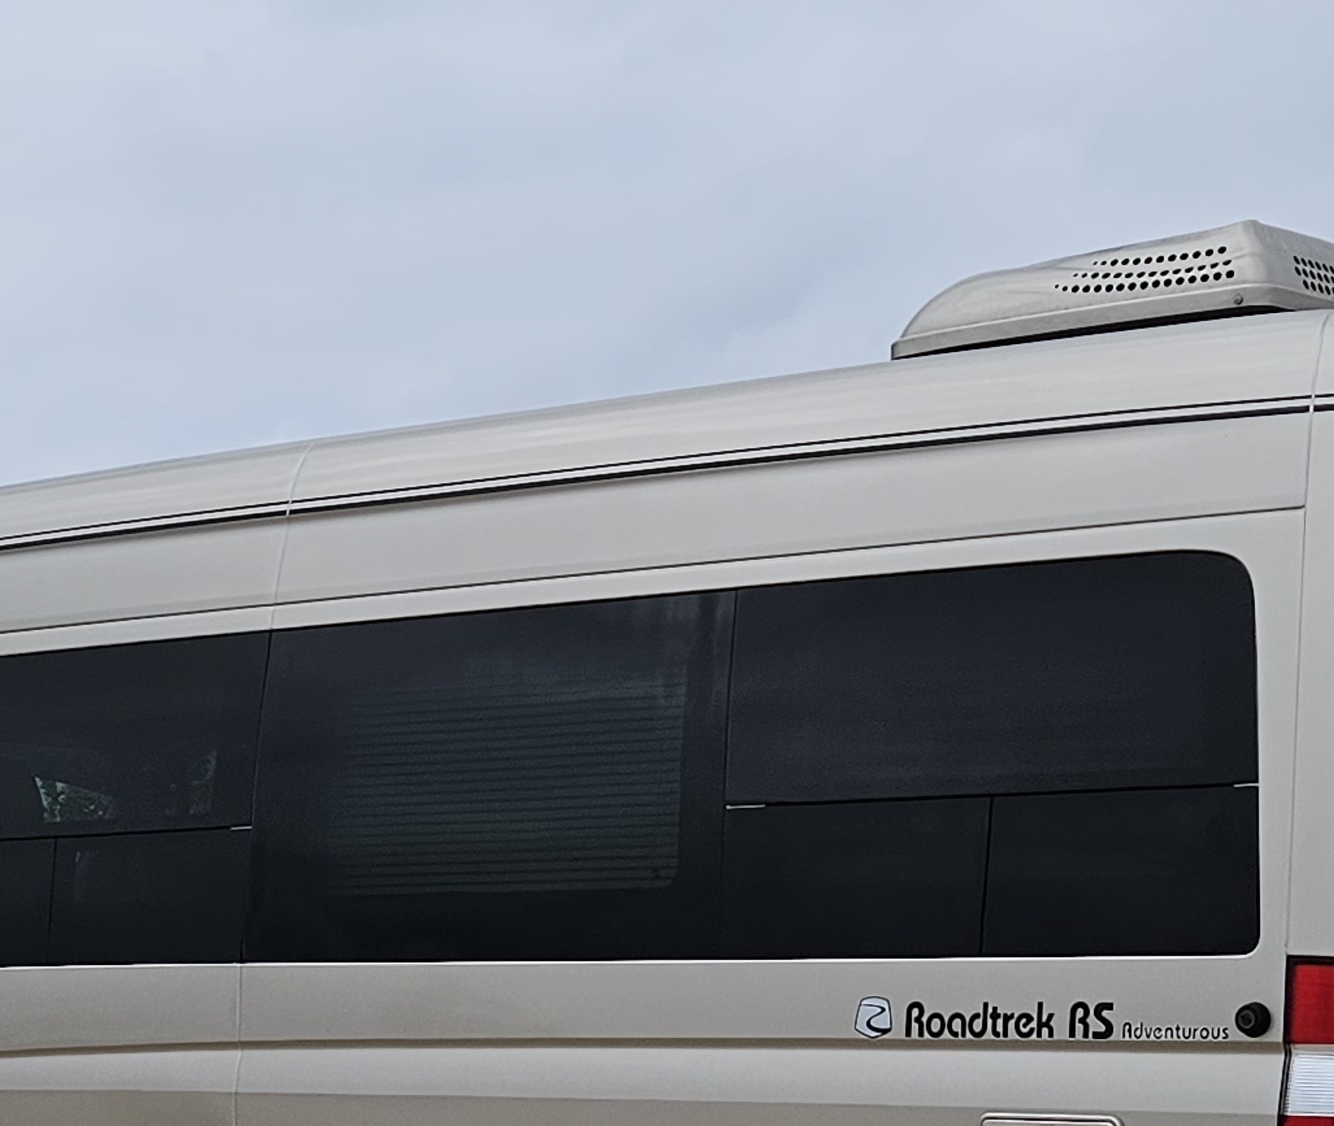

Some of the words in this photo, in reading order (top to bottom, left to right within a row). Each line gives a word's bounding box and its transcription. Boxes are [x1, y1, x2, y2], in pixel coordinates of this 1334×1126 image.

[905, 1001, 1055, 1039] Roadtrek
[1068, 1001, 1114, 1040] RS
[1122, 1021, 1230, 1040] Adventurous
